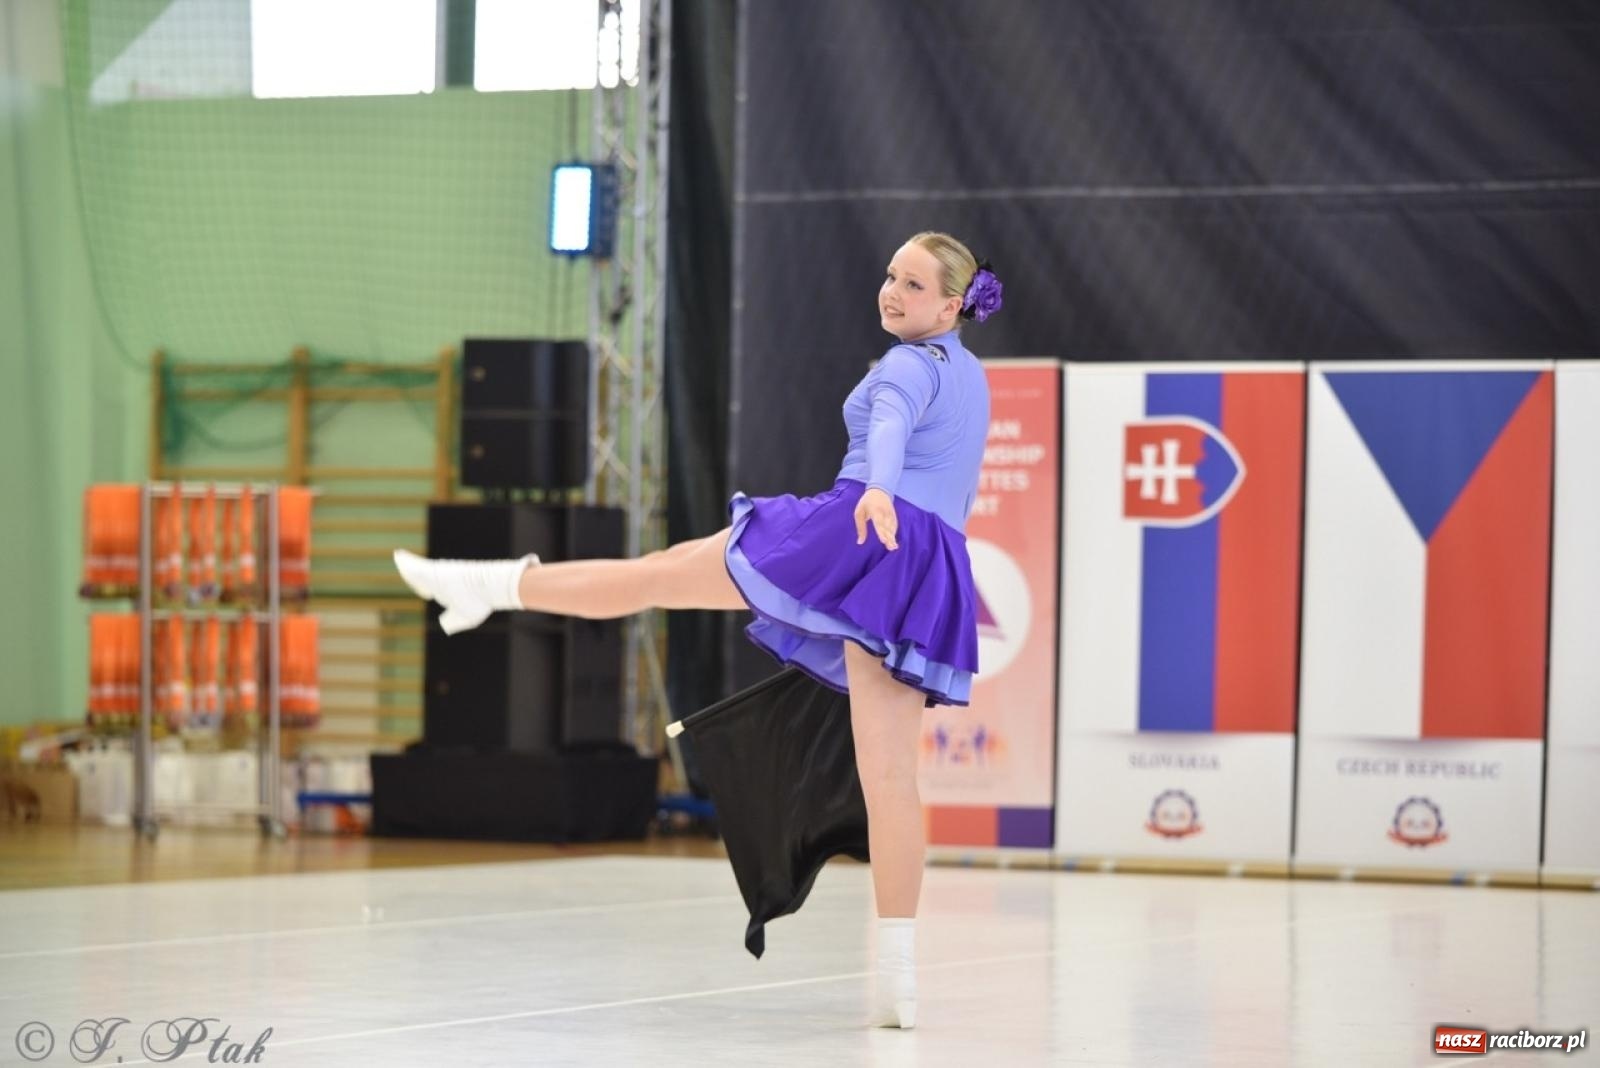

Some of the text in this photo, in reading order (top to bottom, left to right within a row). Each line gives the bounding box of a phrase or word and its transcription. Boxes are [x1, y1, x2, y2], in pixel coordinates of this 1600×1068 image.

[989, 420, 1021, 439] AN
[984, 444, 1044, 464] NSHIP
[978, 470, 1029, 490] TTES
[1128, 753, 1220, 770] SLOVAKIA
[1336, 757, 1502, 778] CZECH REPUBLIC
